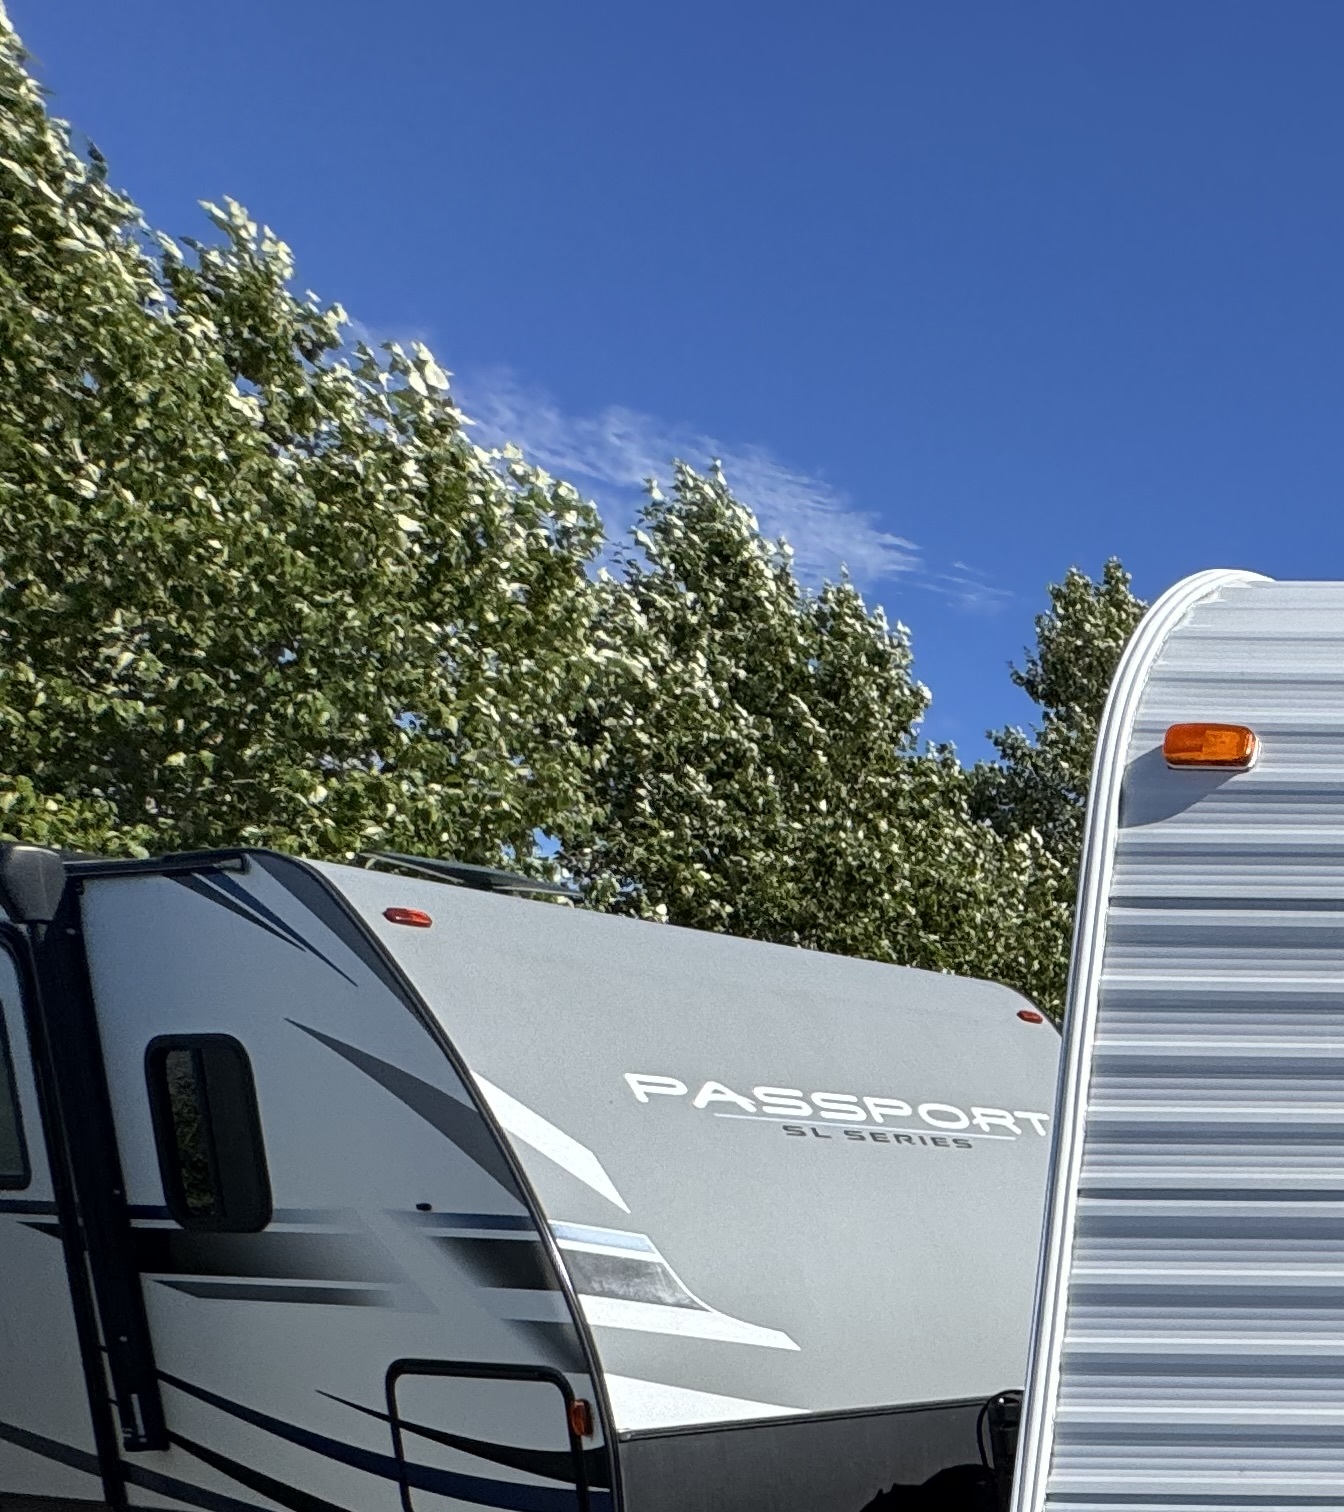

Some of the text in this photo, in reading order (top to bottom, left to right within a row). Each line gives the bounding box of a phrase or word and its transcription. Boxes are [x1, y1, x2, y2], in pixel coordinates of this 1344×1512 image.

[623, 1072, 1051, 1137] PASSPORT
[782, 1124, 974, 1150] SL SERIES
